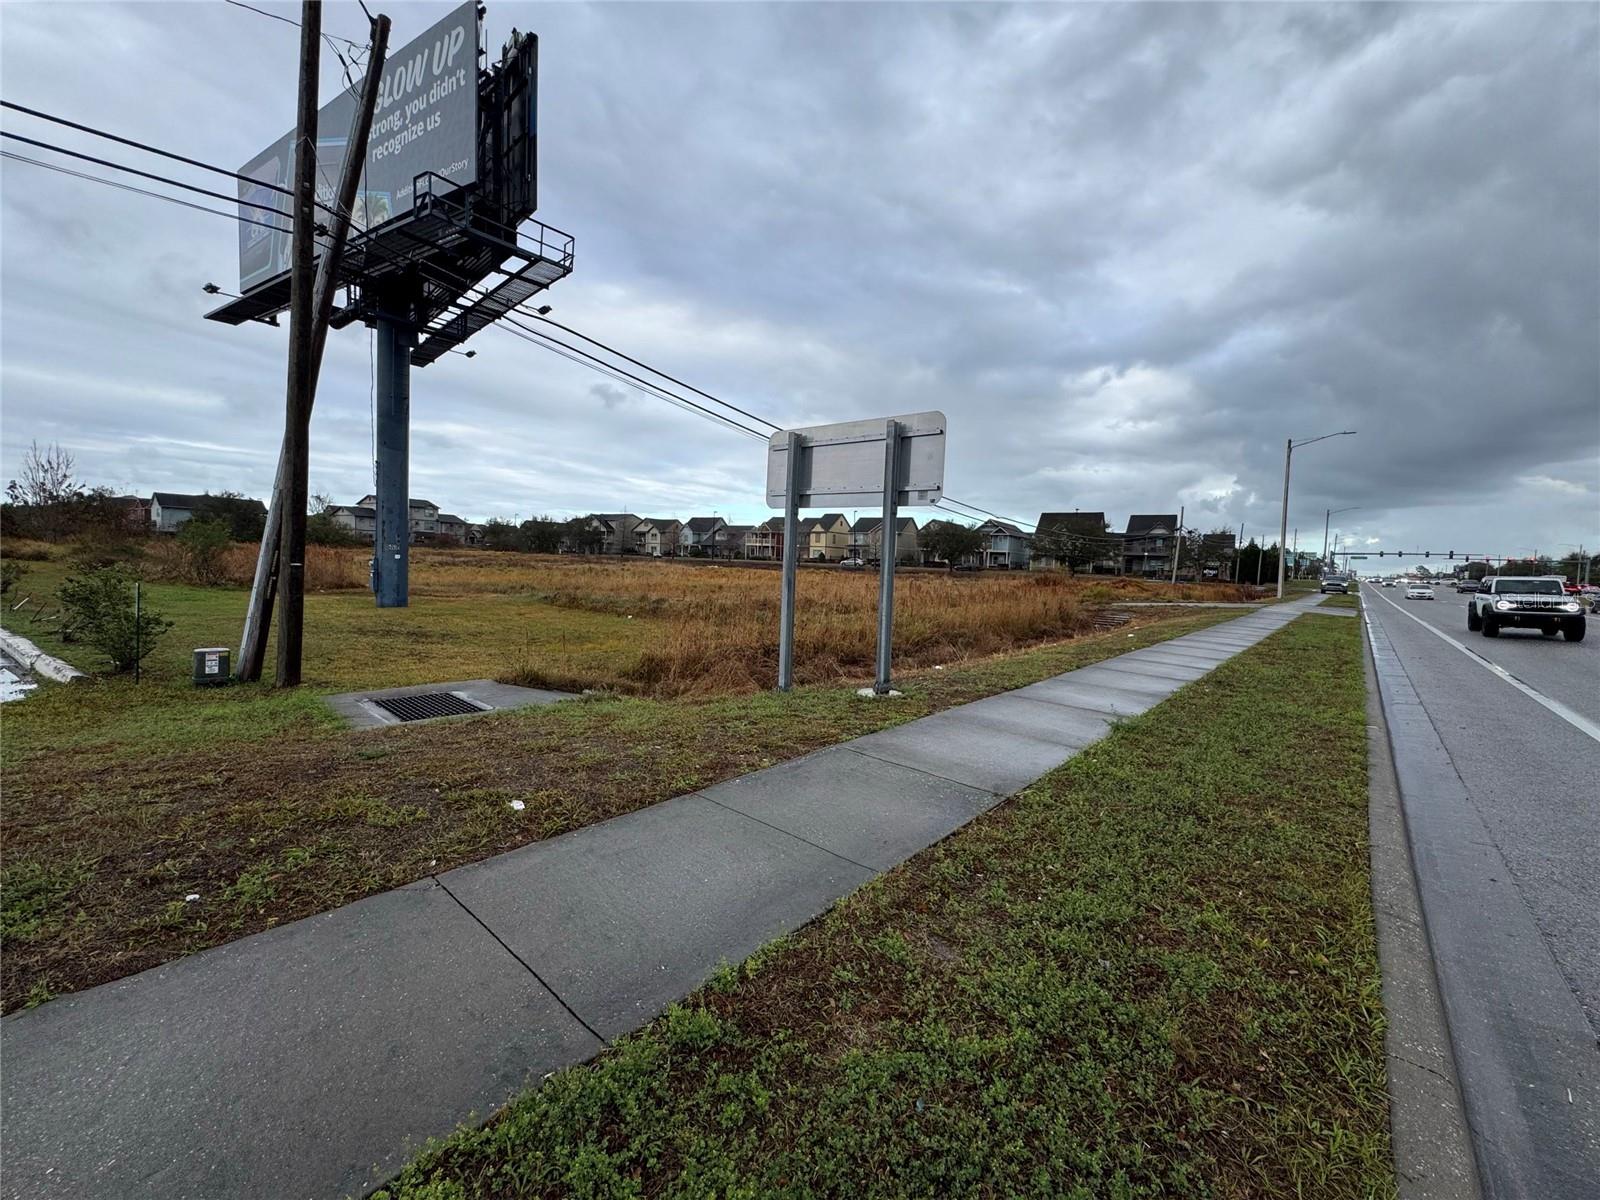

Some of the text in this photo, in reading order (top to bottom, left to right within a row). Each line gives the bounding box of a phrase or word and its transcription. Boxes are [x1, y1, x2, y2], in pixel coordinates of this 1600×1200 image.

[432, 25, 466, 76] UP
[405, 93, 427, 124] you
[429, 68, 467, 103] didn't
[372, 111, 441, 163] recognize us
